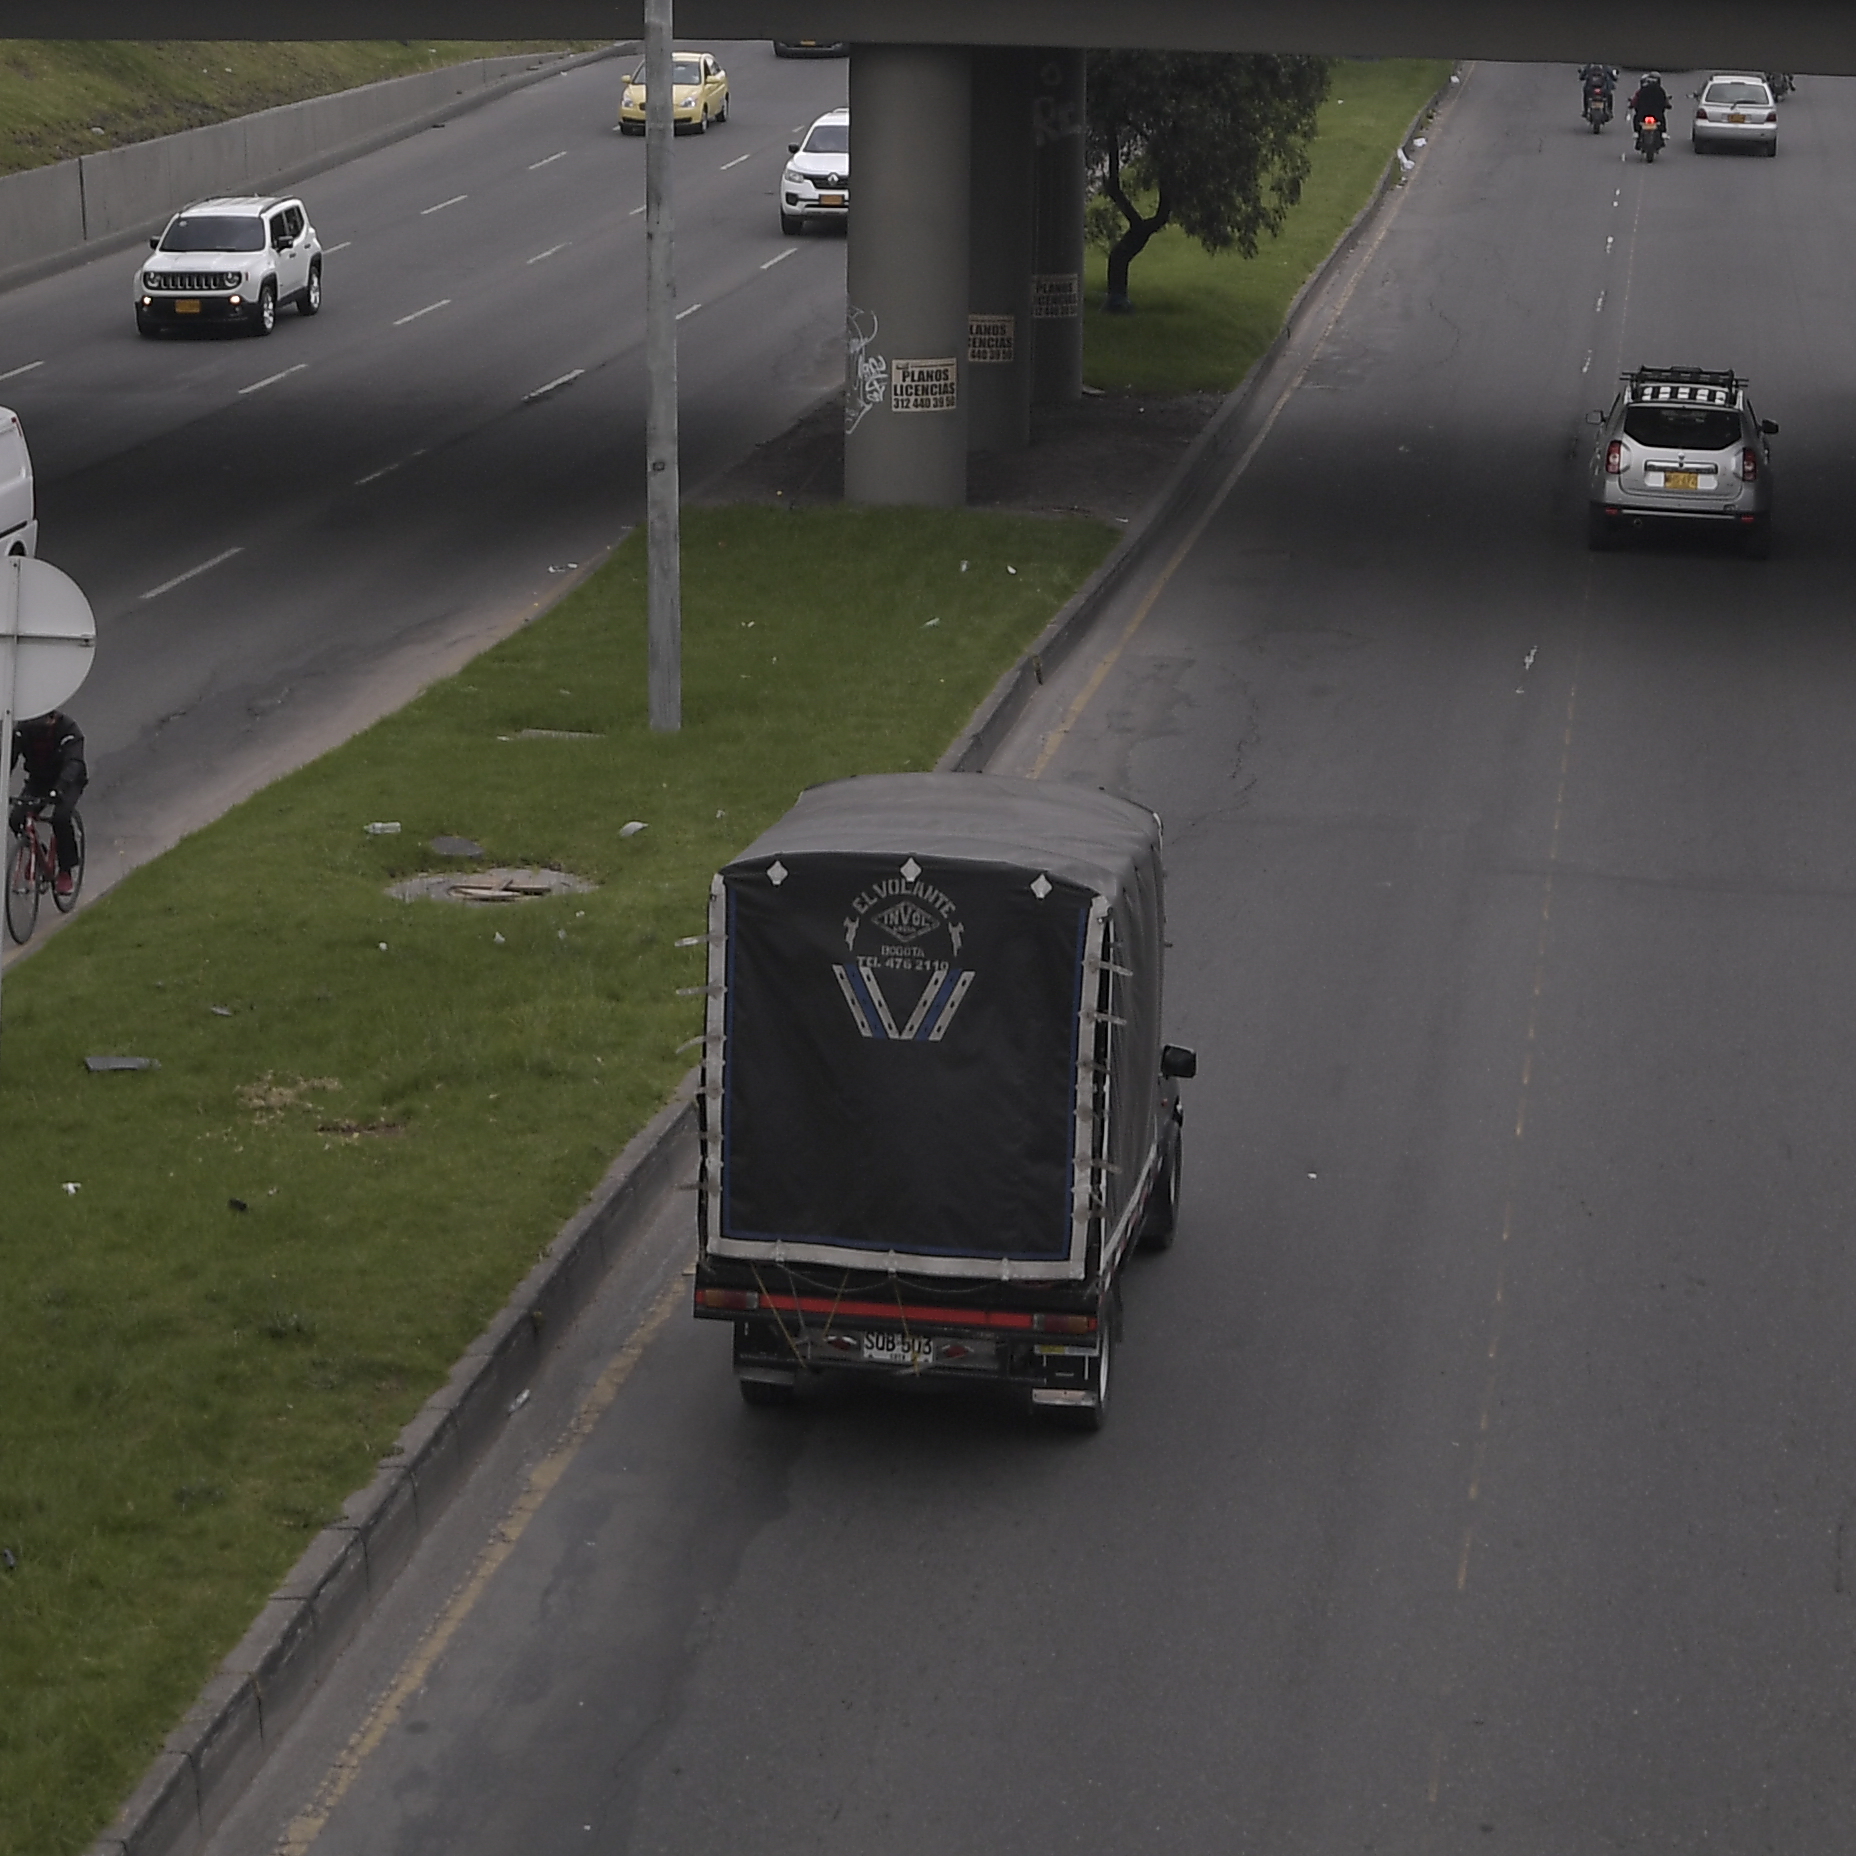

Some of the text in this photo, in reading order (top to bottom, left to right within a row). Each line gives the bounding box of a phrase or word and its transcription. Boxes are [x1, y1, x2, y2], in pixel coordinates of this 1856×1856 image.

[969, 325, 1006, 335] LANOS
[902, 369, 949, 382] PLANOS
[893, 382, 955, 397] LICENCIAS
[893, 397, 910, 409] 312
[913, 397, 931, 409] 440
[933, 396, 945, 408] 39
[852, 878, 956, 919] EL VOLANTE
[881, 945, 925, 957] BOGOTA
[885, 957, 912, 970] 476
